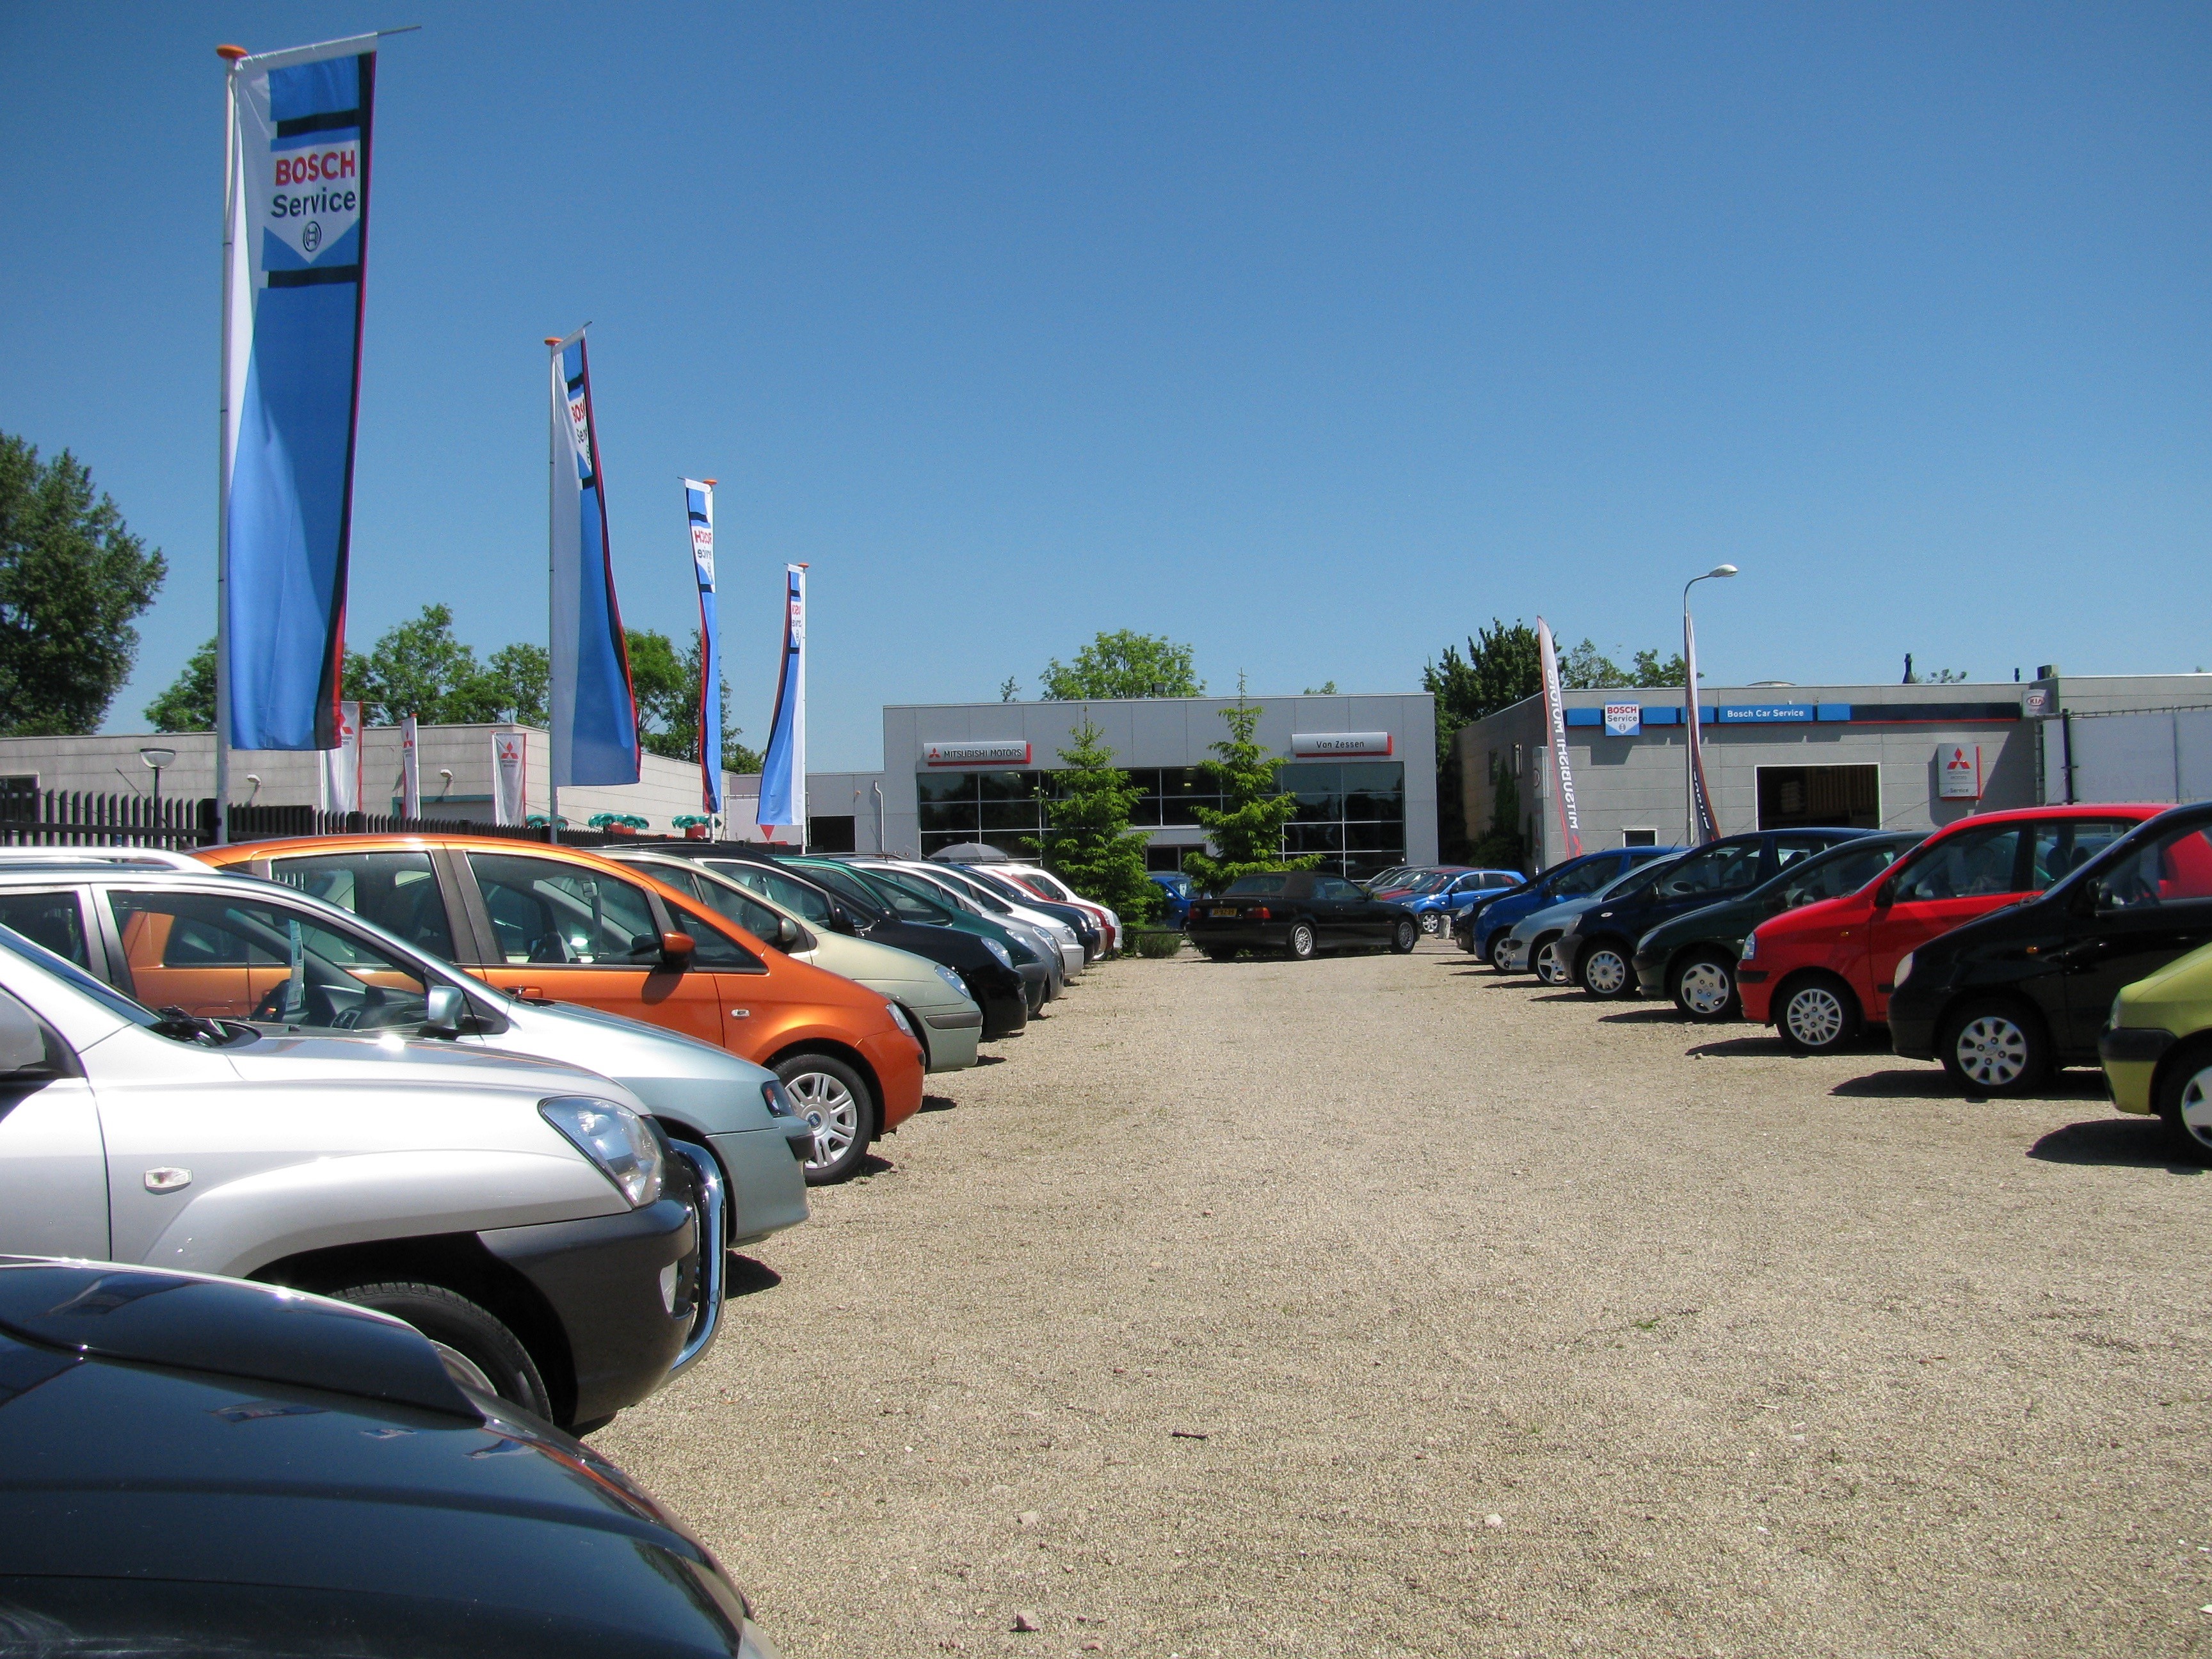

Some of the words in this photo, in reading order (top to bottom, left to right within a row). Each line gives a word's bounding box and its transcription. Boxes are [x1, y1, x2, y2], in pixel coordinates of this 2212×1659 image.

[275, 150, 356, 186] BOSCH
[271, 187, 357, 218] Service
[944, 749, 988, 758] MITSUBISHI
[991, 748, 1022, 757] MOTORS
